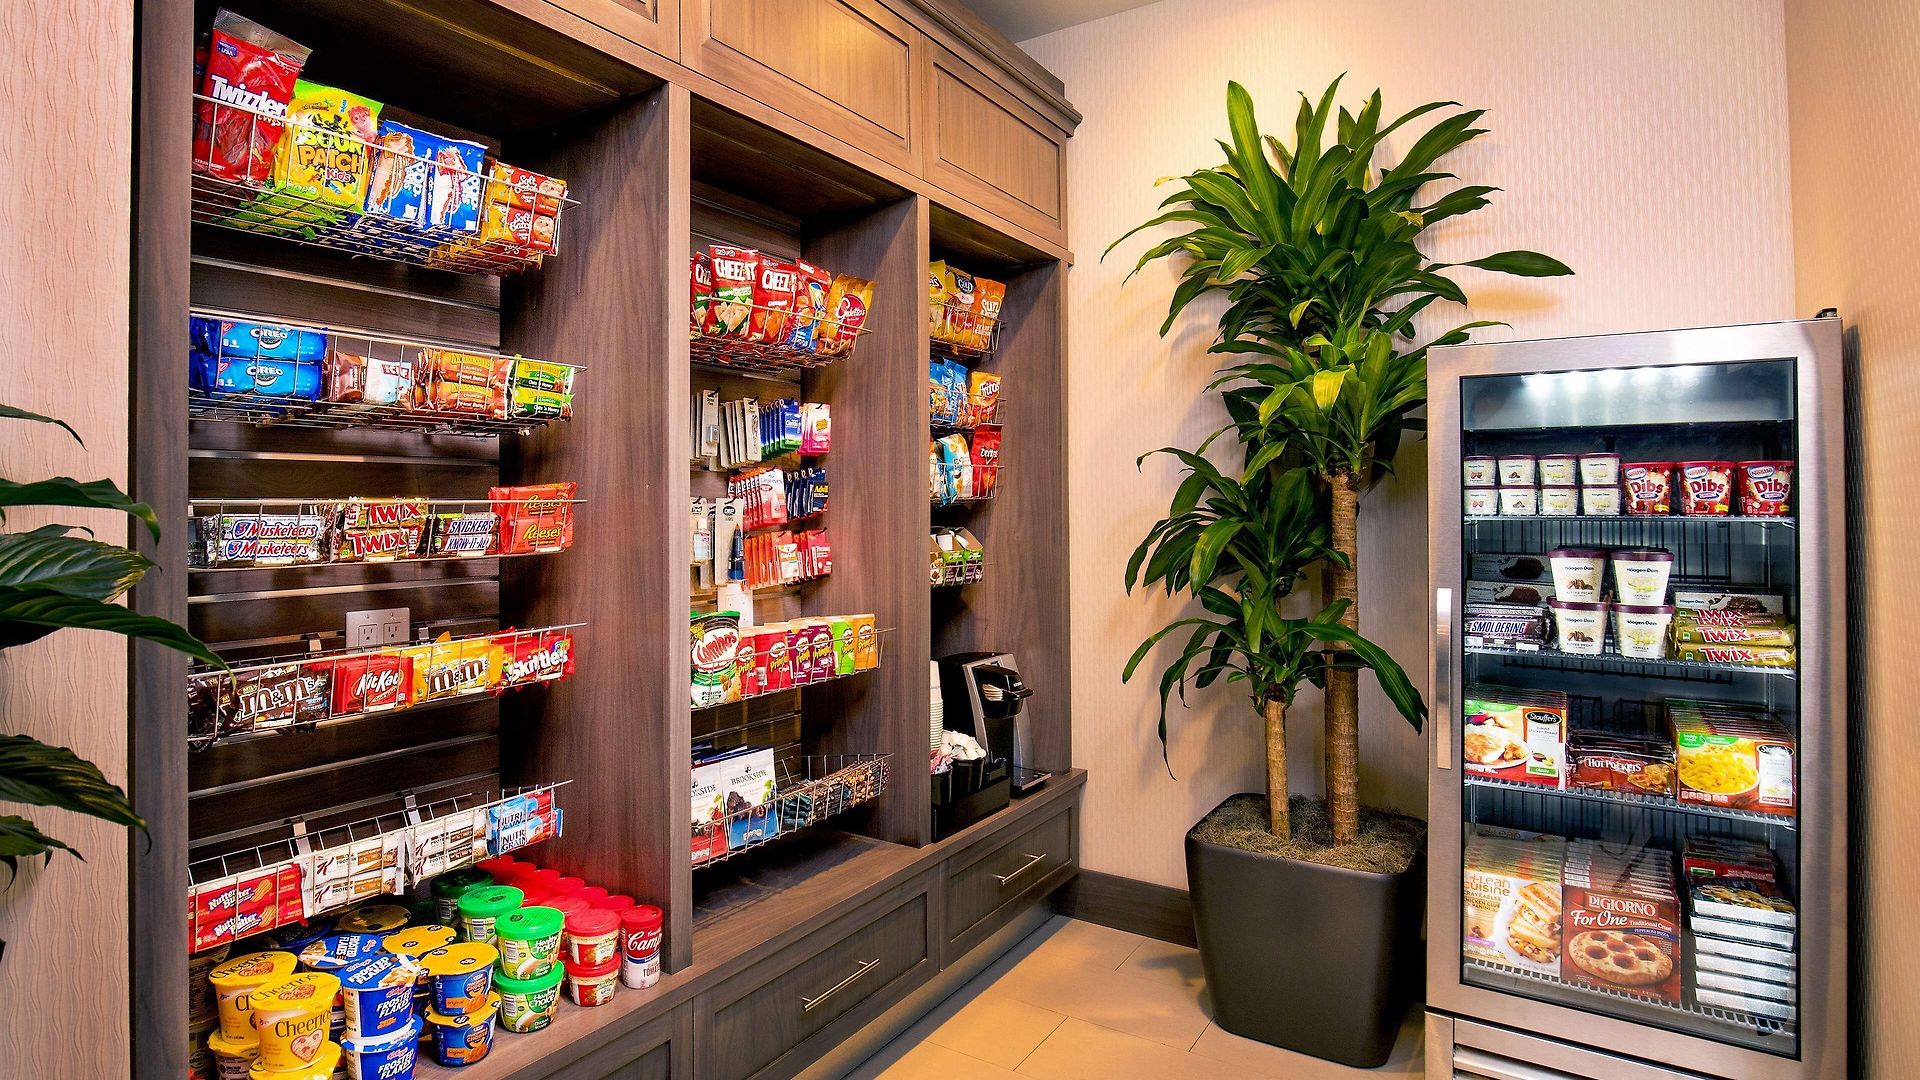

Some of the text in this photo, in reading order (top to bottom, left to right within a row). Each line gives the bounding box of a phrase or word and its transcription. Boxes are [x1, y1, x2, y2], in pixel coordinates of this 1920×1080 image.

[299, 145, 363, 175] PATCH
[325, 168, 353, 183] Kids
[249, 327, 288, 340] OREO
[246, 365, 284, 377] OREO
[813, 485, 829, 493] Advil
[1630, 479, 1664, 494] Dibs
[1690, 479, 1725, 494] Dibs
[1753, 478, 1790, 494] Dibs
[363, 502, 421, 526] TWIX
[246, 521, 317, 537] Musketeers
[448, 520, 494, 534] SNICKERS
[346, 530, 408, 556] TWIX
[1472, 621, 1526, 635] SMOLDERING
[1697, 627, 1751, 643] TWIX
[697, 632, 738, 663] Combos
[1700, 646, 1755, 662] TWIX
[507, 649, 569, 682] Skittles
[1588, 758, 1642, 773] HOT POCKETS
[731, 769, 769, 786] BROOKSIDE
[1570, 909, 1628, 927] For One
[1630, 919, 1673, 932] Traditional Crust
[209, 952, 274, 980] Cheerios
[249, 972, 320, 1002] Cheerios
